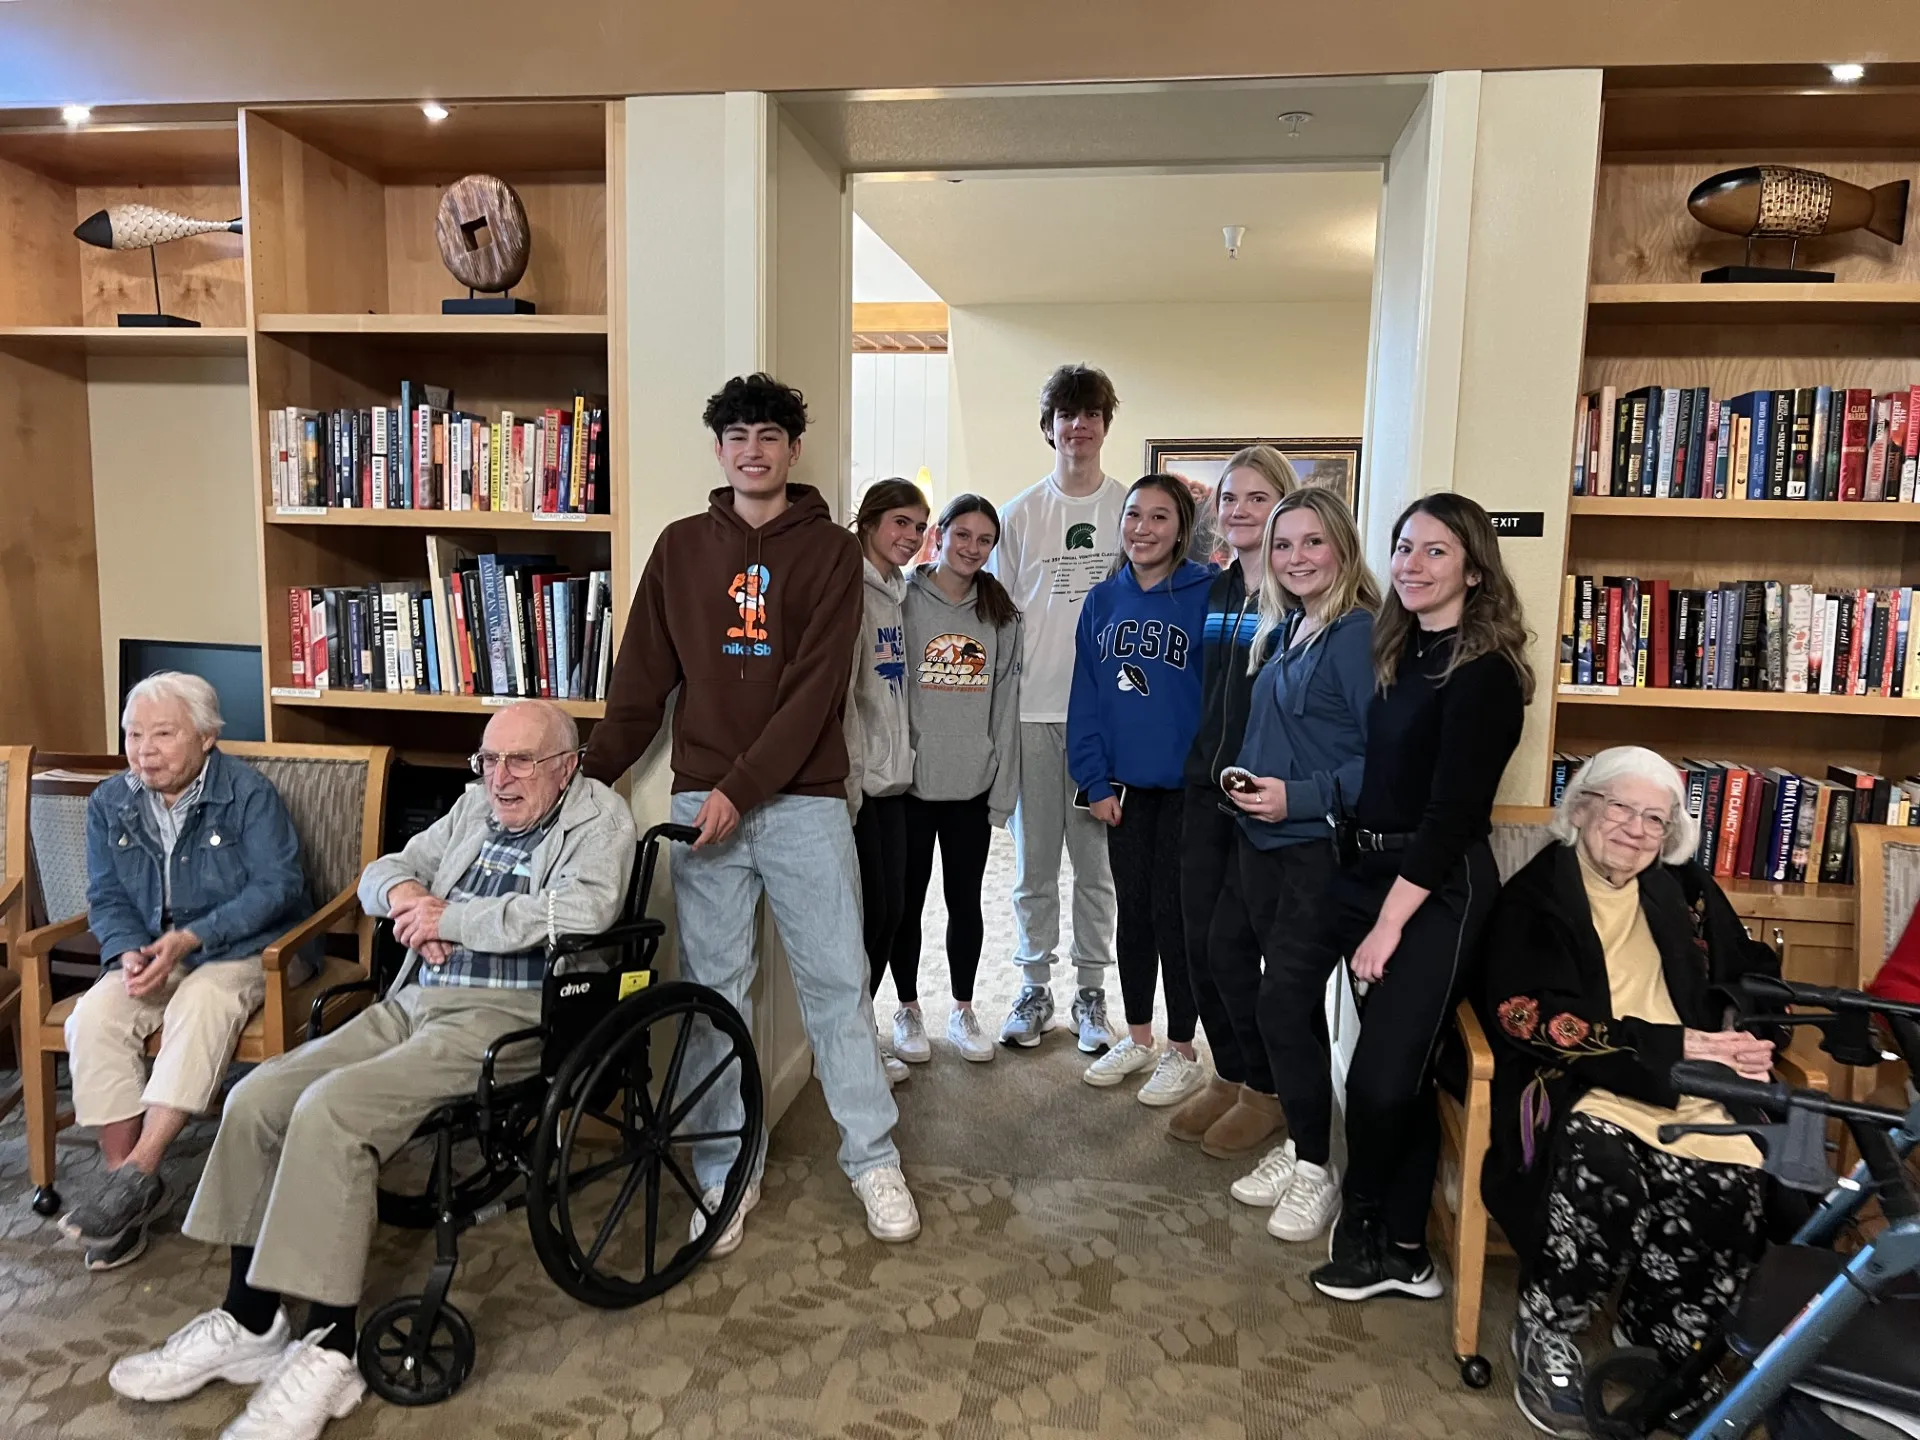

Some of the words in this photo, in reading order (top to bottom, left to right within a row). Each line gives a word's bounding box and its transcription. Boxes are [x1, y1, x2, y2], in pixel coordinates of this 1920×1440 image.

[1667, 392, 1678, 416] DAVID
[1681, 392, 1690, 419] SANDRA
[1759, 401, 1767, 418] DAVID
[1776, 395, 1784, 420] BALDACCI
[421, 410, 429, 434] ERNIE
[1892, 401, 1902, 430] BERENSON
[1900, 409, 1908, 423] ALEX
[1631, 419, 1643, 444] ARTHUR
[1663, 417, 1676, 454] BALDACCI
[1679, 420, 1687, 445] BROWN
[1757, 419, 1766, 445] BALDACCI
[376, 434, 386, 452] CROSS
[421, 436, 429, 459] PYLE'S
[1776, 432, 1786, 456] SIMPLE
[1872, 443, 1884, 463] MARY
[1707, 443, 1715, 465] DEADLY
[1775, 457, 1784, 481] TRUTH
[1870, 463, 1882, 481] MARY
[1490, 518, 1520, 528] EXIT
[483, 561, 498, 612] AMERICAN
[1582, 580, 1592, 600] LARRY
[411, 599, 419, 618] LARRY
[1582, 601, 1592, 619] BOND
[1598, 602, 1607, 614] THE
[1680, 597, 1689, 616] ALLISON
[1728, 593, 1736, 619] SANDRA
[1746, 588, 1762, 617] SANDRA
[290, 594, 300, 635] DOUBLE
[1841, 604, 1849, 626] never
[386, 633, 394, 646] THE
[1596, 615, 1606, 646] HIGHWAY
[1726, 621, 1734, 644] BROWN
[1742, 620, 1759, 645] BROWN
[1840, 628, 1848, 644] tell
[293, 638, 302, 659] ACE
[414, 649, 422, 662] EXIT
[722, 643, 752, 656] nike
[386, 647, 396, 678] OUTPOST
[918, 661, 974, 674] SAND
[918, 673, 989, 686] STORM
[1556, 765, 1567, 784] TOM
[1709, 775, 1721, 793] TOM
[1692, 784, 1703, 796] LEE
[1730, 778, 1744, 796] TOM
[1784, 780, 1800, 796] TOM
[1690, 796, 1702, 815] CHILD
[1704, 794, 1718, 829] CLANCY
[1726, 798, 1741, 834] CLANCY
[1780, 798, 1797, 827] CLANCY
[560, 982, 591, 998] drive
